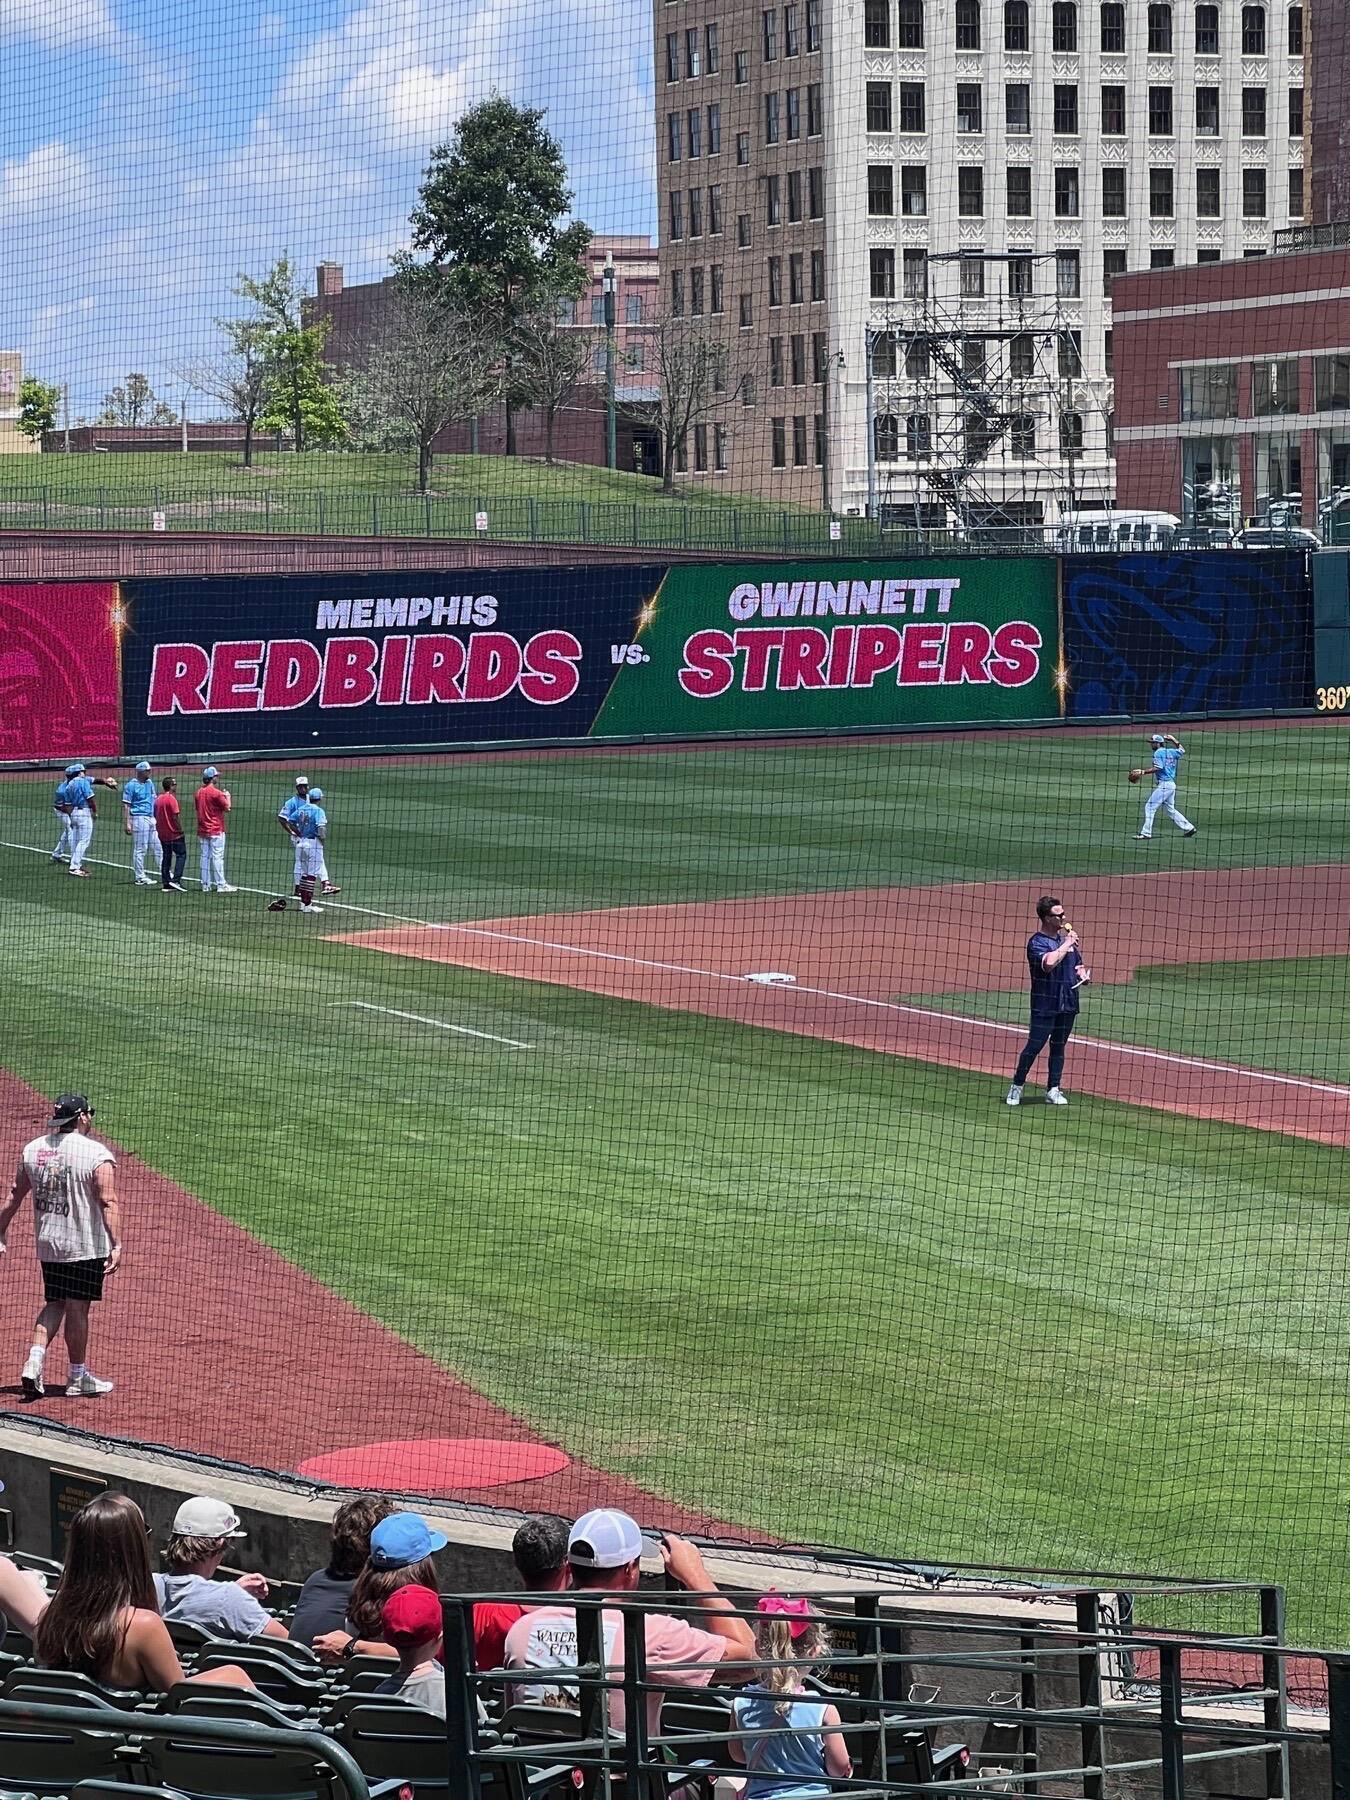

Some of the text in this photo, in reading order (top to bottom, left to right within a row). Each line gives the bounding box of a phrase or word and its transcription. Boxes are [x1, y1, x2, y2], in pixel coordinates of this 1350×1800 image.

[316, 595, 499, 630] MEMPHIS
[728, 578, 961, 621] GWINNETT
[147, 630, 583, 716] REDBIRDS
[677, 621, 1043, 698] STRIPERS
[536, 1629, 577, 1643] WATER
[549, 1643, 578, 1657] FLY
